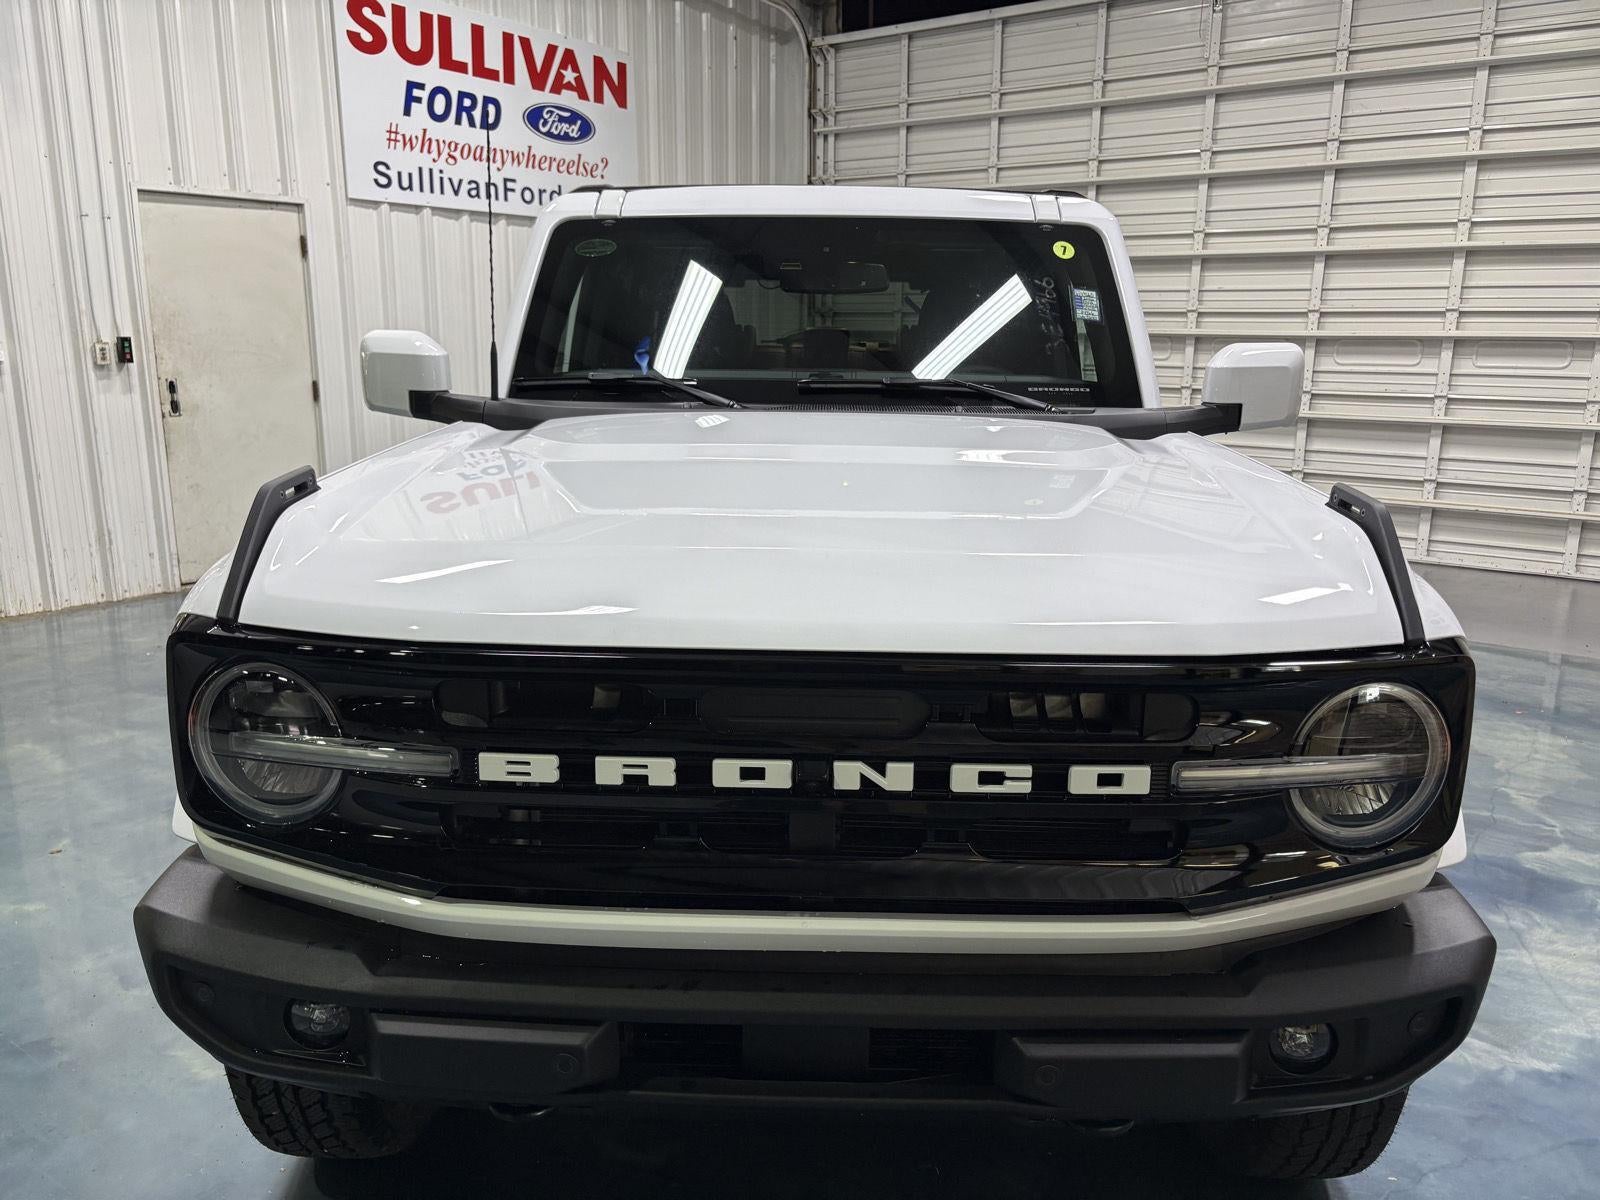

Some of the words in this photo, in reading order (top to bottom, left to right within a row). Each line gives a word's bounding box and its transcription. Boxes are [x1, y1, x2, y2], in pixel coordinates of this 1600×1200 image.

[346, 0, 628, 110] SULLIVAN
[403, 80, 502, 131] FORD
[538, 107, 581, 139] Ford
[386, 122, 609, 180] #whygoanywhereelse?
[478, 752, 1151, 795] BRONCO
